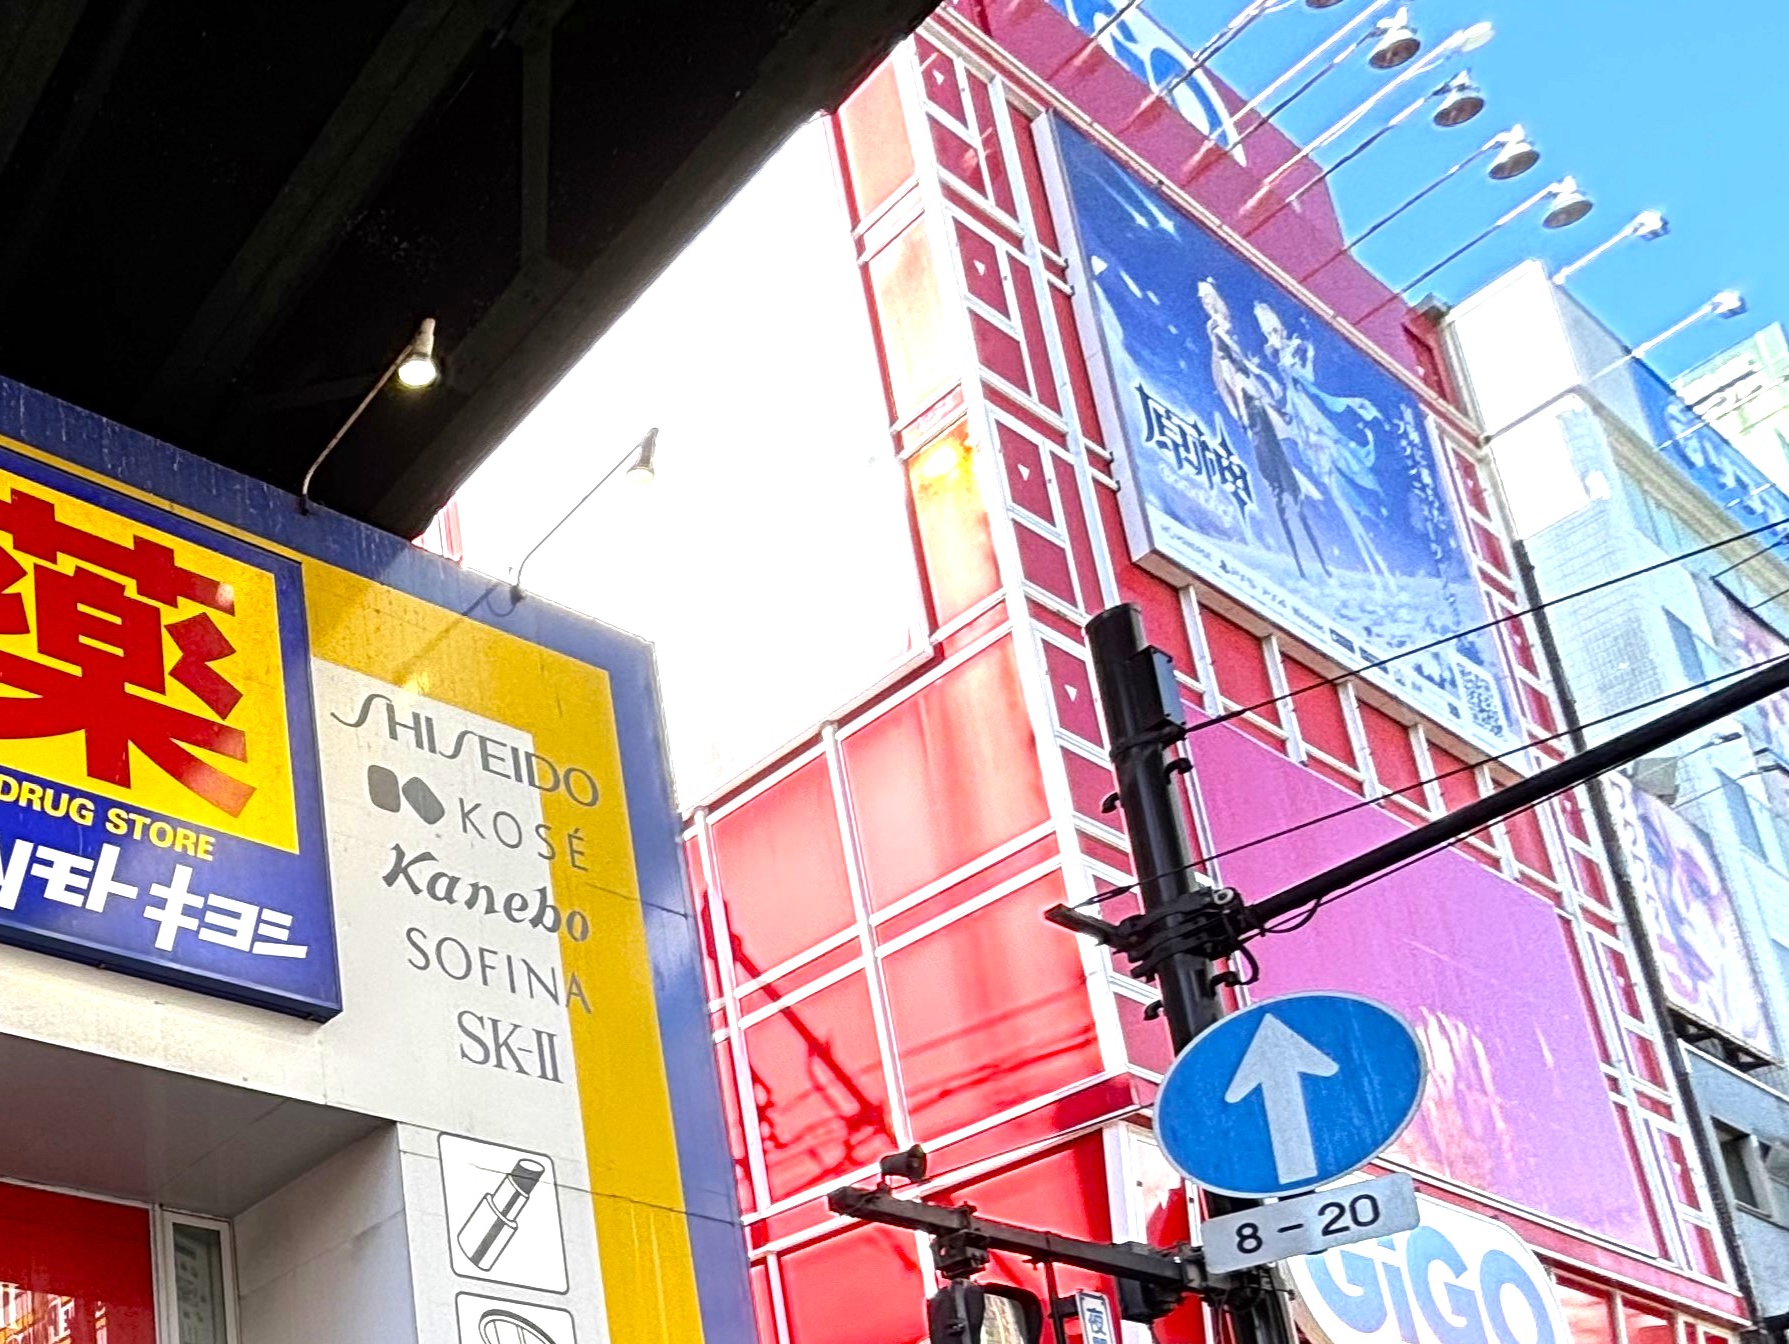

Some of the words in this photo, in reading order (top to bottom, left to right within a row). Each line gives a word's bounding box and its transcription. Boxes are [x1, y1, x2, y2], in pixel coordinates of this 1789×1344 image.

[330, 693, 600, 807] SHISEIDO
[105, 806, 216, 862] STORE
[458, 797, 589, 873] KOSÉ
[382, 843, 590, 942] Kanebo
[405, 927, 593, 1014] SOFINA
[457, 1010, 564, 1083] SK-II
